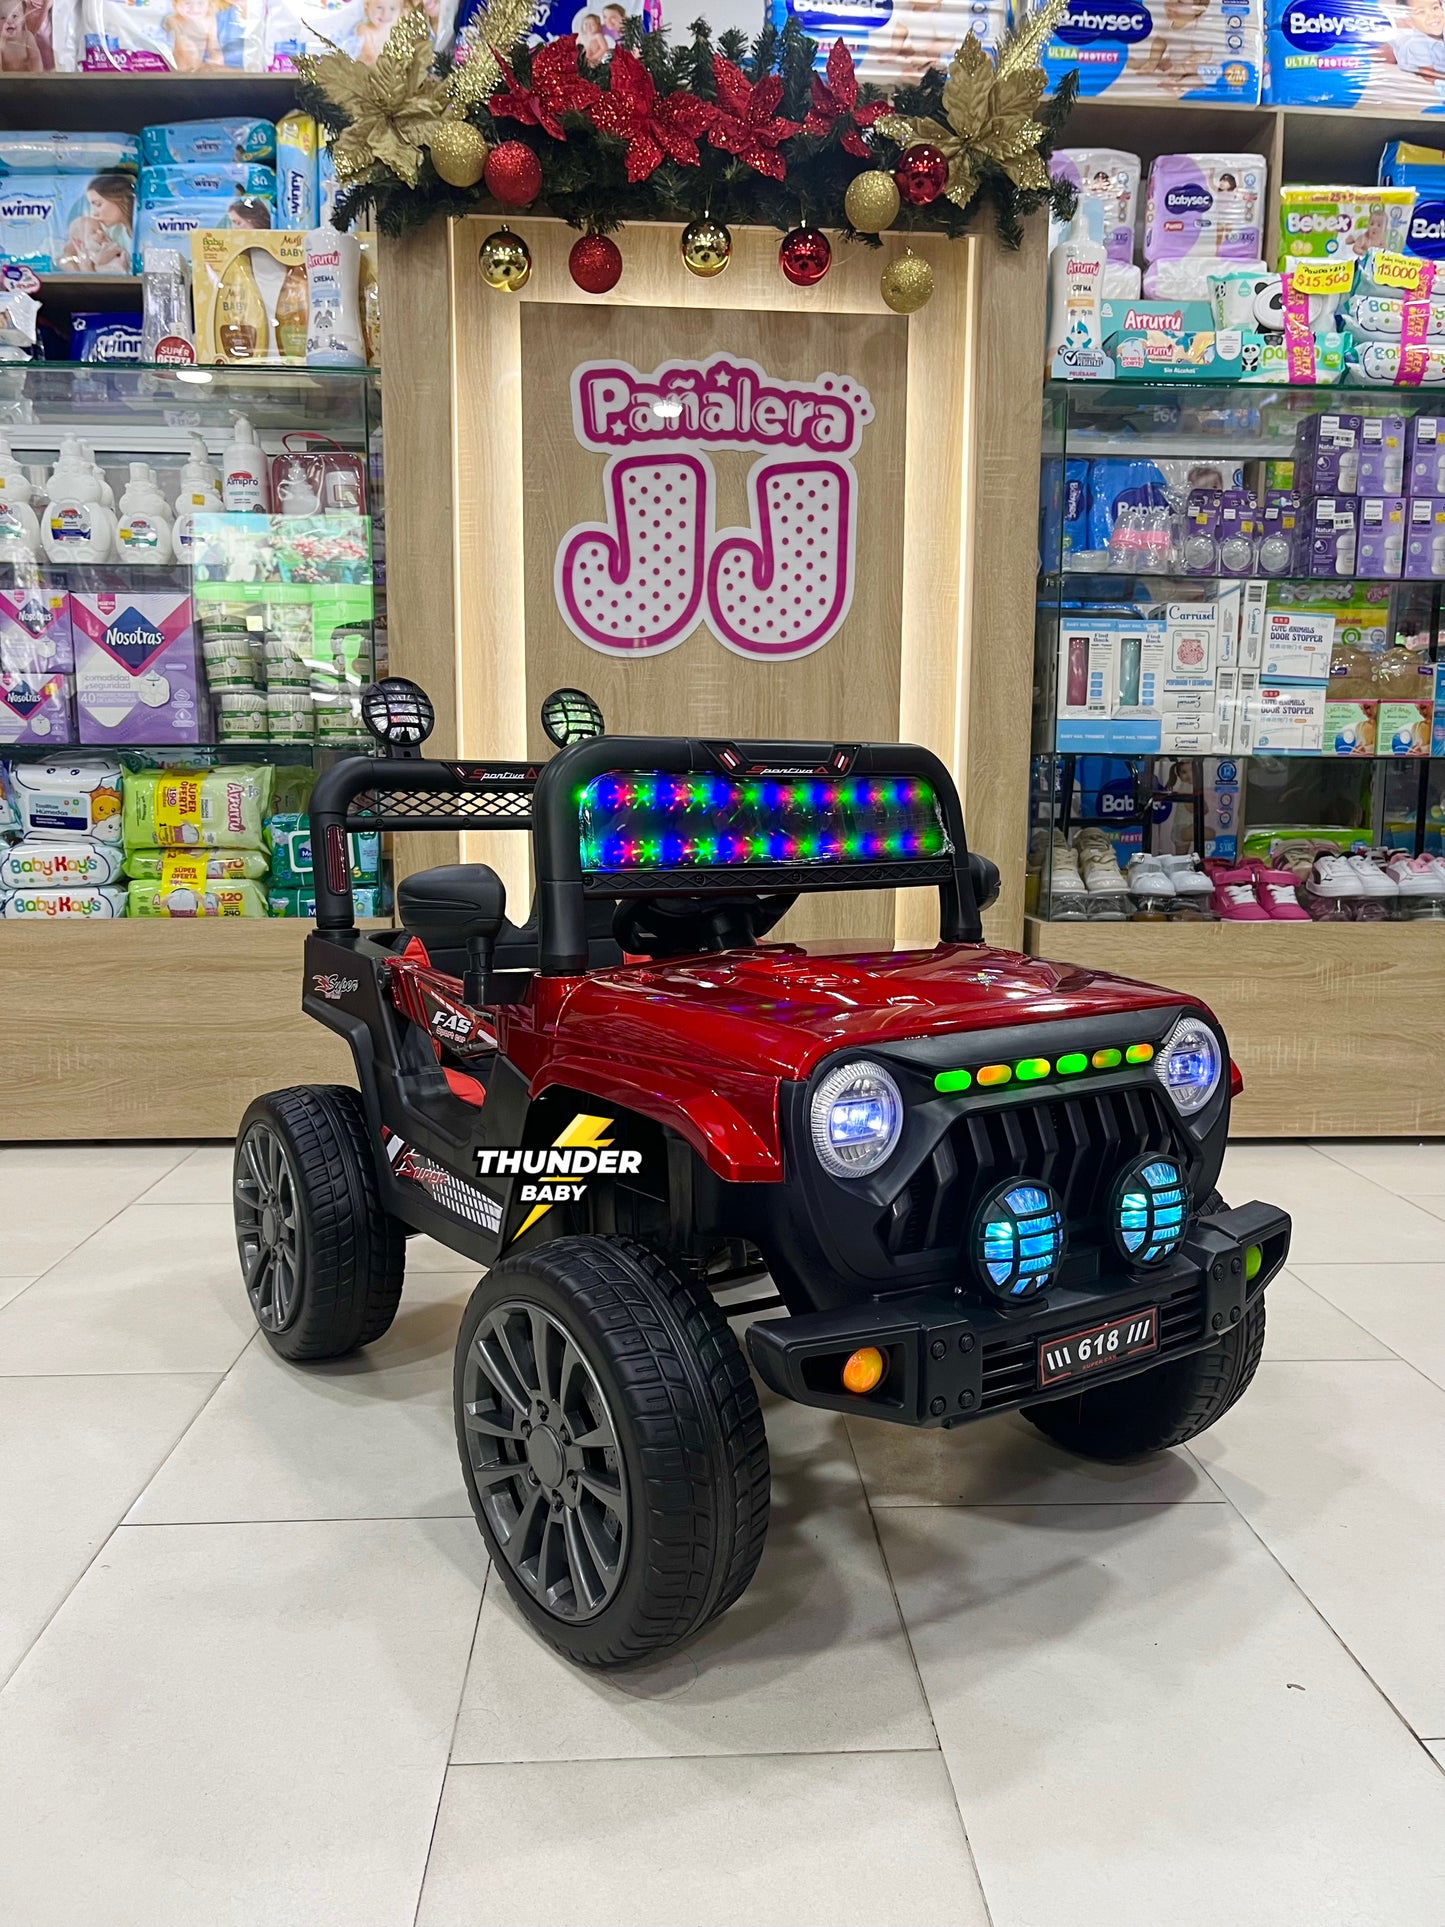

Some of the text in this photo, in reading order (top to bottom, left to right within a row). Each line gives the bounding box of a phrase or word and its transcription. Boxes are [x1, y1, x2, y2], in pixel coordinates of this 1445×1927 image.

[1078, 53, 1118, 62] PROTECT
[1285, 57, 1316, 68] ULTRA
[195, 141, 220, 151] winny
[194, 177, 220, 189] winny
[291, 170, 304, 215] winny
[1168, 194, 1210, 206] Babysec
[1, 201, 51, 219] winny
[1287, 212, 1350, 233] Bebex
[280, 249, 303, 257] BABY
[1369, 300, 1402, 313] Bab
[1125, 309, 1182, 330] Arrurrú
[1146, 344, 1173, 356] rrurrú
[588, 376, 847, 444] Pañalera
[226, 478, 259, 487] Almipro
[18, 611, 53, 622] Nosotras
[1168, 605, 1216, 621] Carrusel
[106, 626, 164, 645] Nosotras
[1271, 632, 1323, 643] DOOR STOPPER
[88, 683, 131, 691] seguridad
[7, 692, 42, 703] Nosotras
[81, 693, 96, 703] 40
[1282, 707, 1314, 715] STOPPER
[168, 788, 178, 806] 190
[179, 781, 189, 815] OFERTA
[10, 856, 98, 876] Baby Kay's
[220, 892, 243, 901] 120
[14, 896, 102, 916] Baby Kay's
[435, 1025, 455, 1040] Sport
[1078, 1329, 1119, 1361] 618
